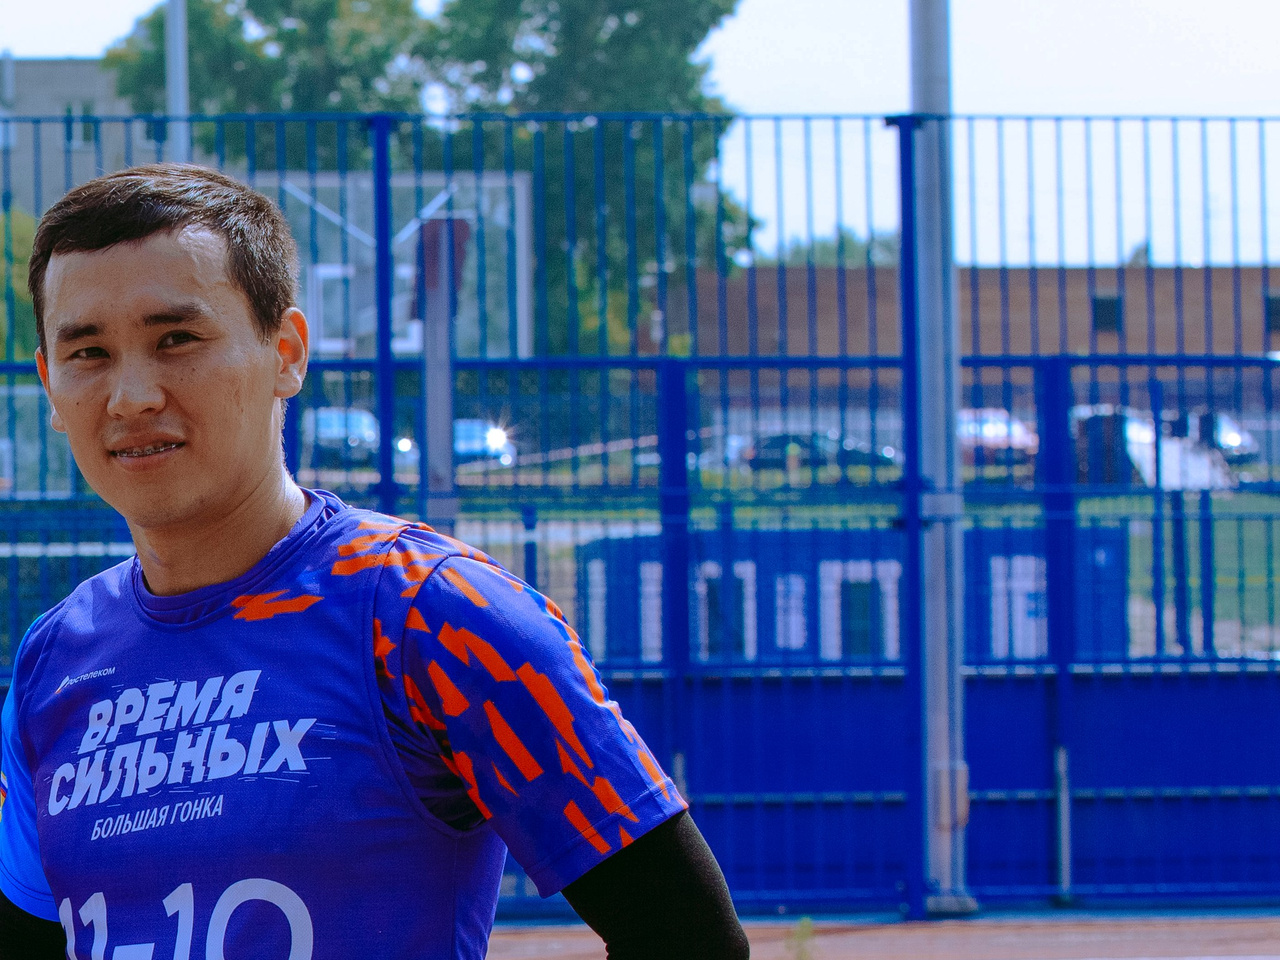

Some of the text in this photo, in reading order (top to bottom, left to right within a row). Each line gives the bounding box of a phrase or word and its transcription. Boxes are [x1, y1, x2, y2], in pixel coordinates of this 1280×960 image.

[77, 669, 262, 755] ВРЕМЯ
[48, 718, 317, 816] СИЛЬНЫХ
[91, 794, 224, 841] БОЛЬШАЯ ГОНКА
